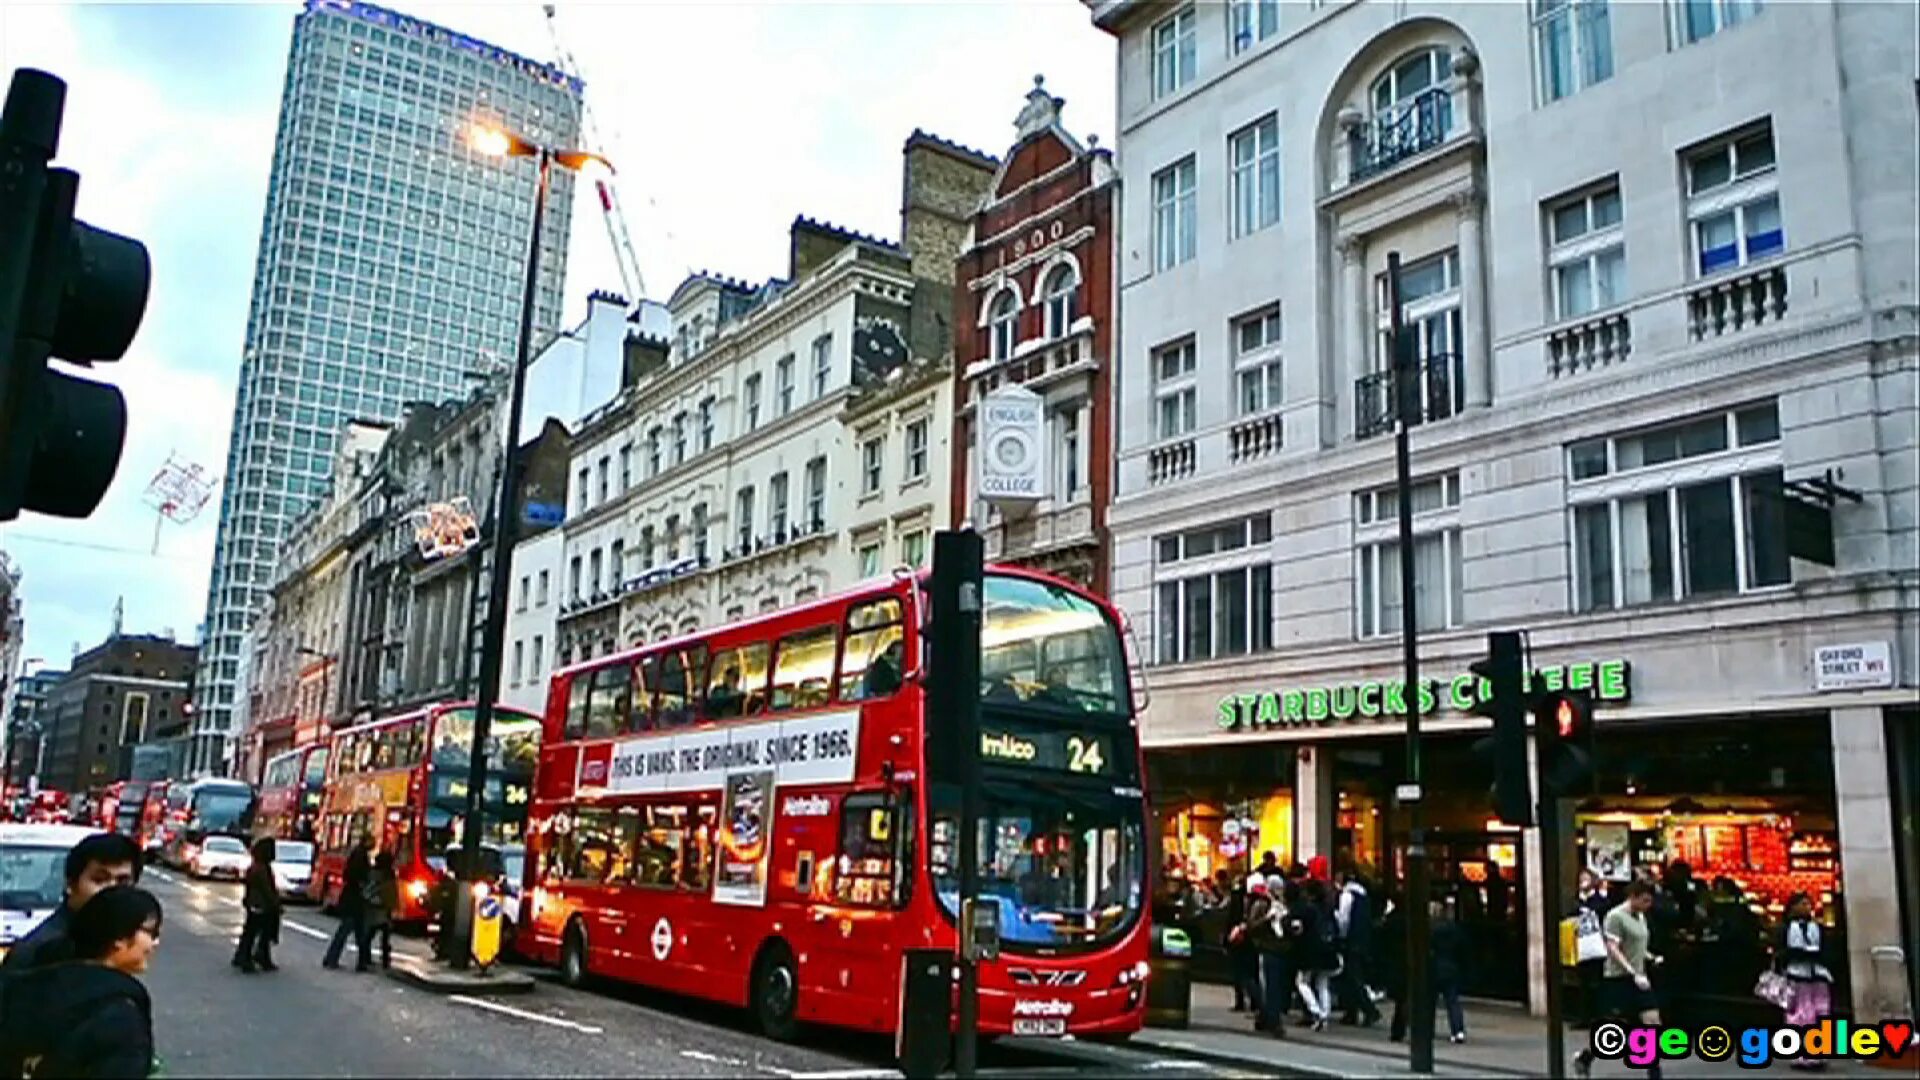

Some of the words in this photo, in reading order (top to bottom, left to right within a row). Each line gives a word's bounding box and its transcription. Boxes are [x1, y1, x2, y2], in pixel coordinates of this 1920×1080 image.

[998, 220, 1064, 265] 1900
[983, 479, 1036, 493] COLLEGE
[1822, 661, 1860, 675] STREET
[1217, 680, 1434, 728] STARBUCKS
[1450, 660, 1626, 710] CFEE
[613, 755, 632, 777] THIS
[635, 753, 644, 776] IS
[680, 748, 700, 772] THE
[703, 739, 760, 770] ORIGINAL
[767, 734, 807, 765] SINCE
[814, 729, 851, 759] 1966.
[981, 733, 1036, 760] imlico
[1066, 737, 1104, 773] 24
[782, 795, 830, 816] Metroline
[1013, 998, 1073, 1016] Metroline
